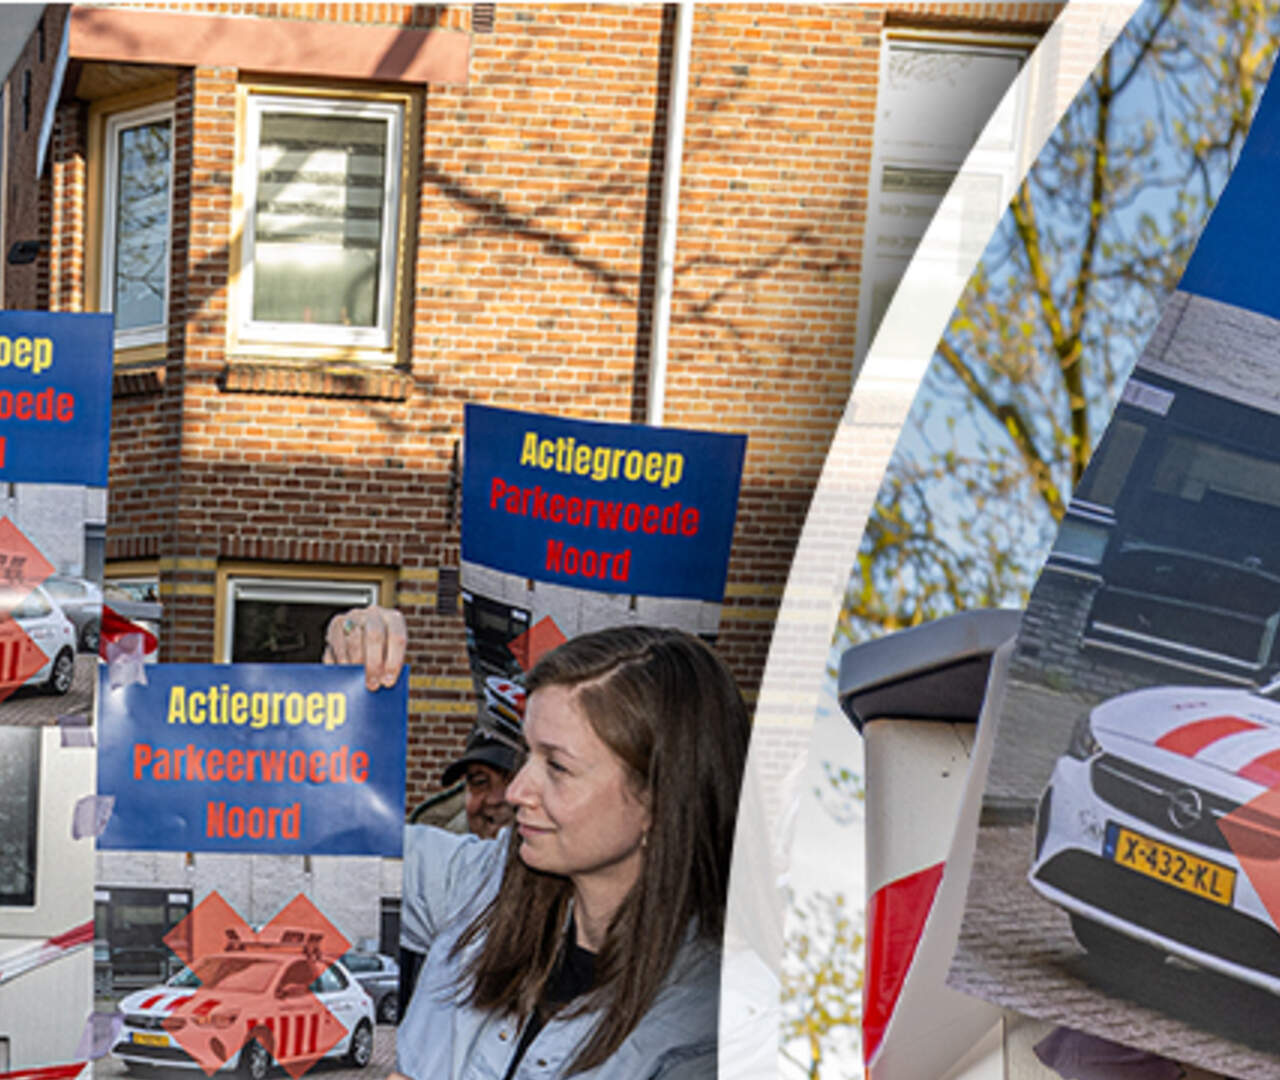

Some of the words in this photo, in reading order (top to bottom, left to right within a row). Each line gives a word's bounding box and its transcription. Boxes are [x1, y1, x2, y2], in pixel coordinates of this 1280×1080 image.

[520, 432, 684, 488] Actiegroep
[489, 477, 700, 537] Parkeerwoede
[545, 539, 632, 582] Noord
[166, 683, 346, 730] Actiegroep
[134, 743, 369, 783] Parkeerwoede
[207, 801, 301, 839] Noord
[1124, 836, 1223, 898] X-432-KL
